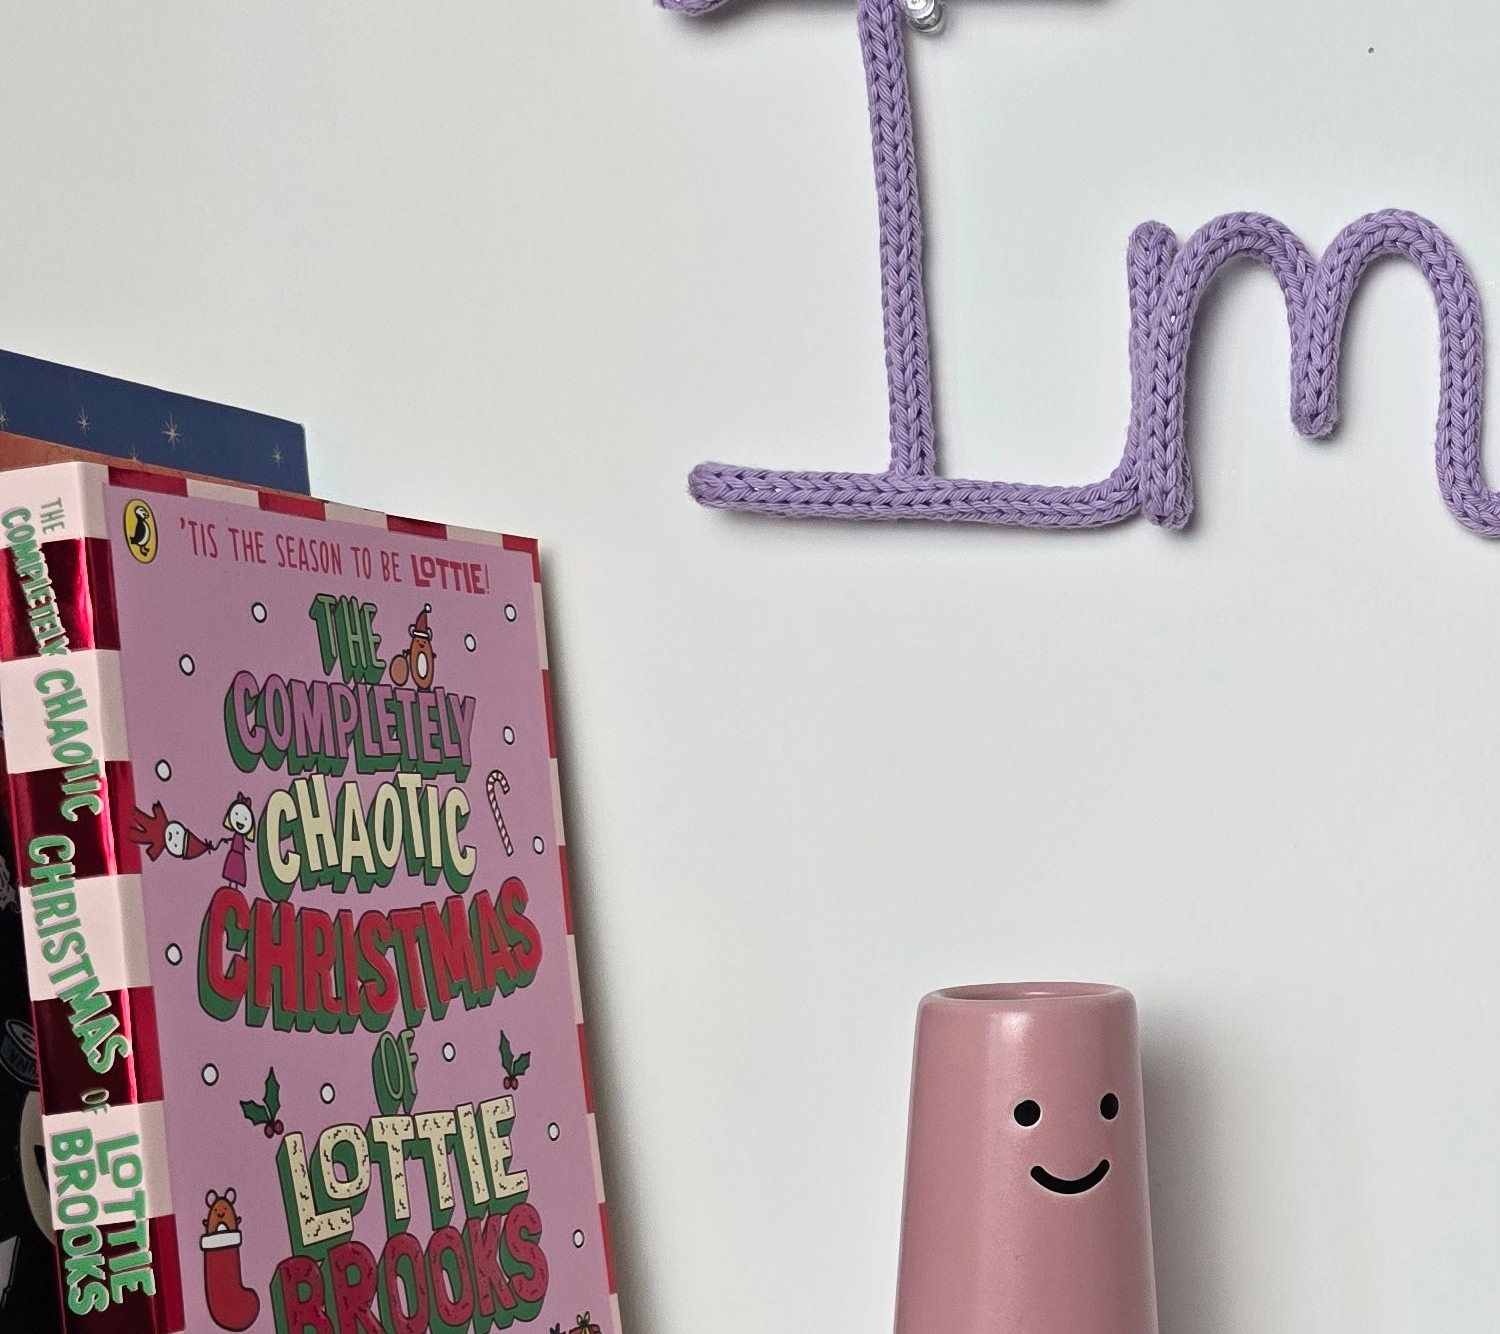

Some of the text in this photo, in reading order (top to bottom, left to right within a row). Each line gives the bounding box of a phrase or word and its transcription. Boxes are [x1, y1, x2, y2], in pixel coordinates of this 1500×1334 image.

[40, 497, 66, 535] THE
[180, 517, 491, 595] 'TIS THE SEASON TO BE LOTTIE!
[313, 594, 387, 675] THE
[228, 670, 477, 775] COMPLETELY
[1, 506, 132, 1116] COMPLETELY CHAOTIC CHRISTMAS OF
[262, 772, 477, 893] CHAOTIC
[202, 876, 543, 1022] CHRISTMAS
[374, 1028, 419, 1107] OF
[51, 1127, 110, 1315] BROOKS
[97, 1132, 157, 1304] LOTTIE
[280, 1095, 530, 1246] LOTTIE
